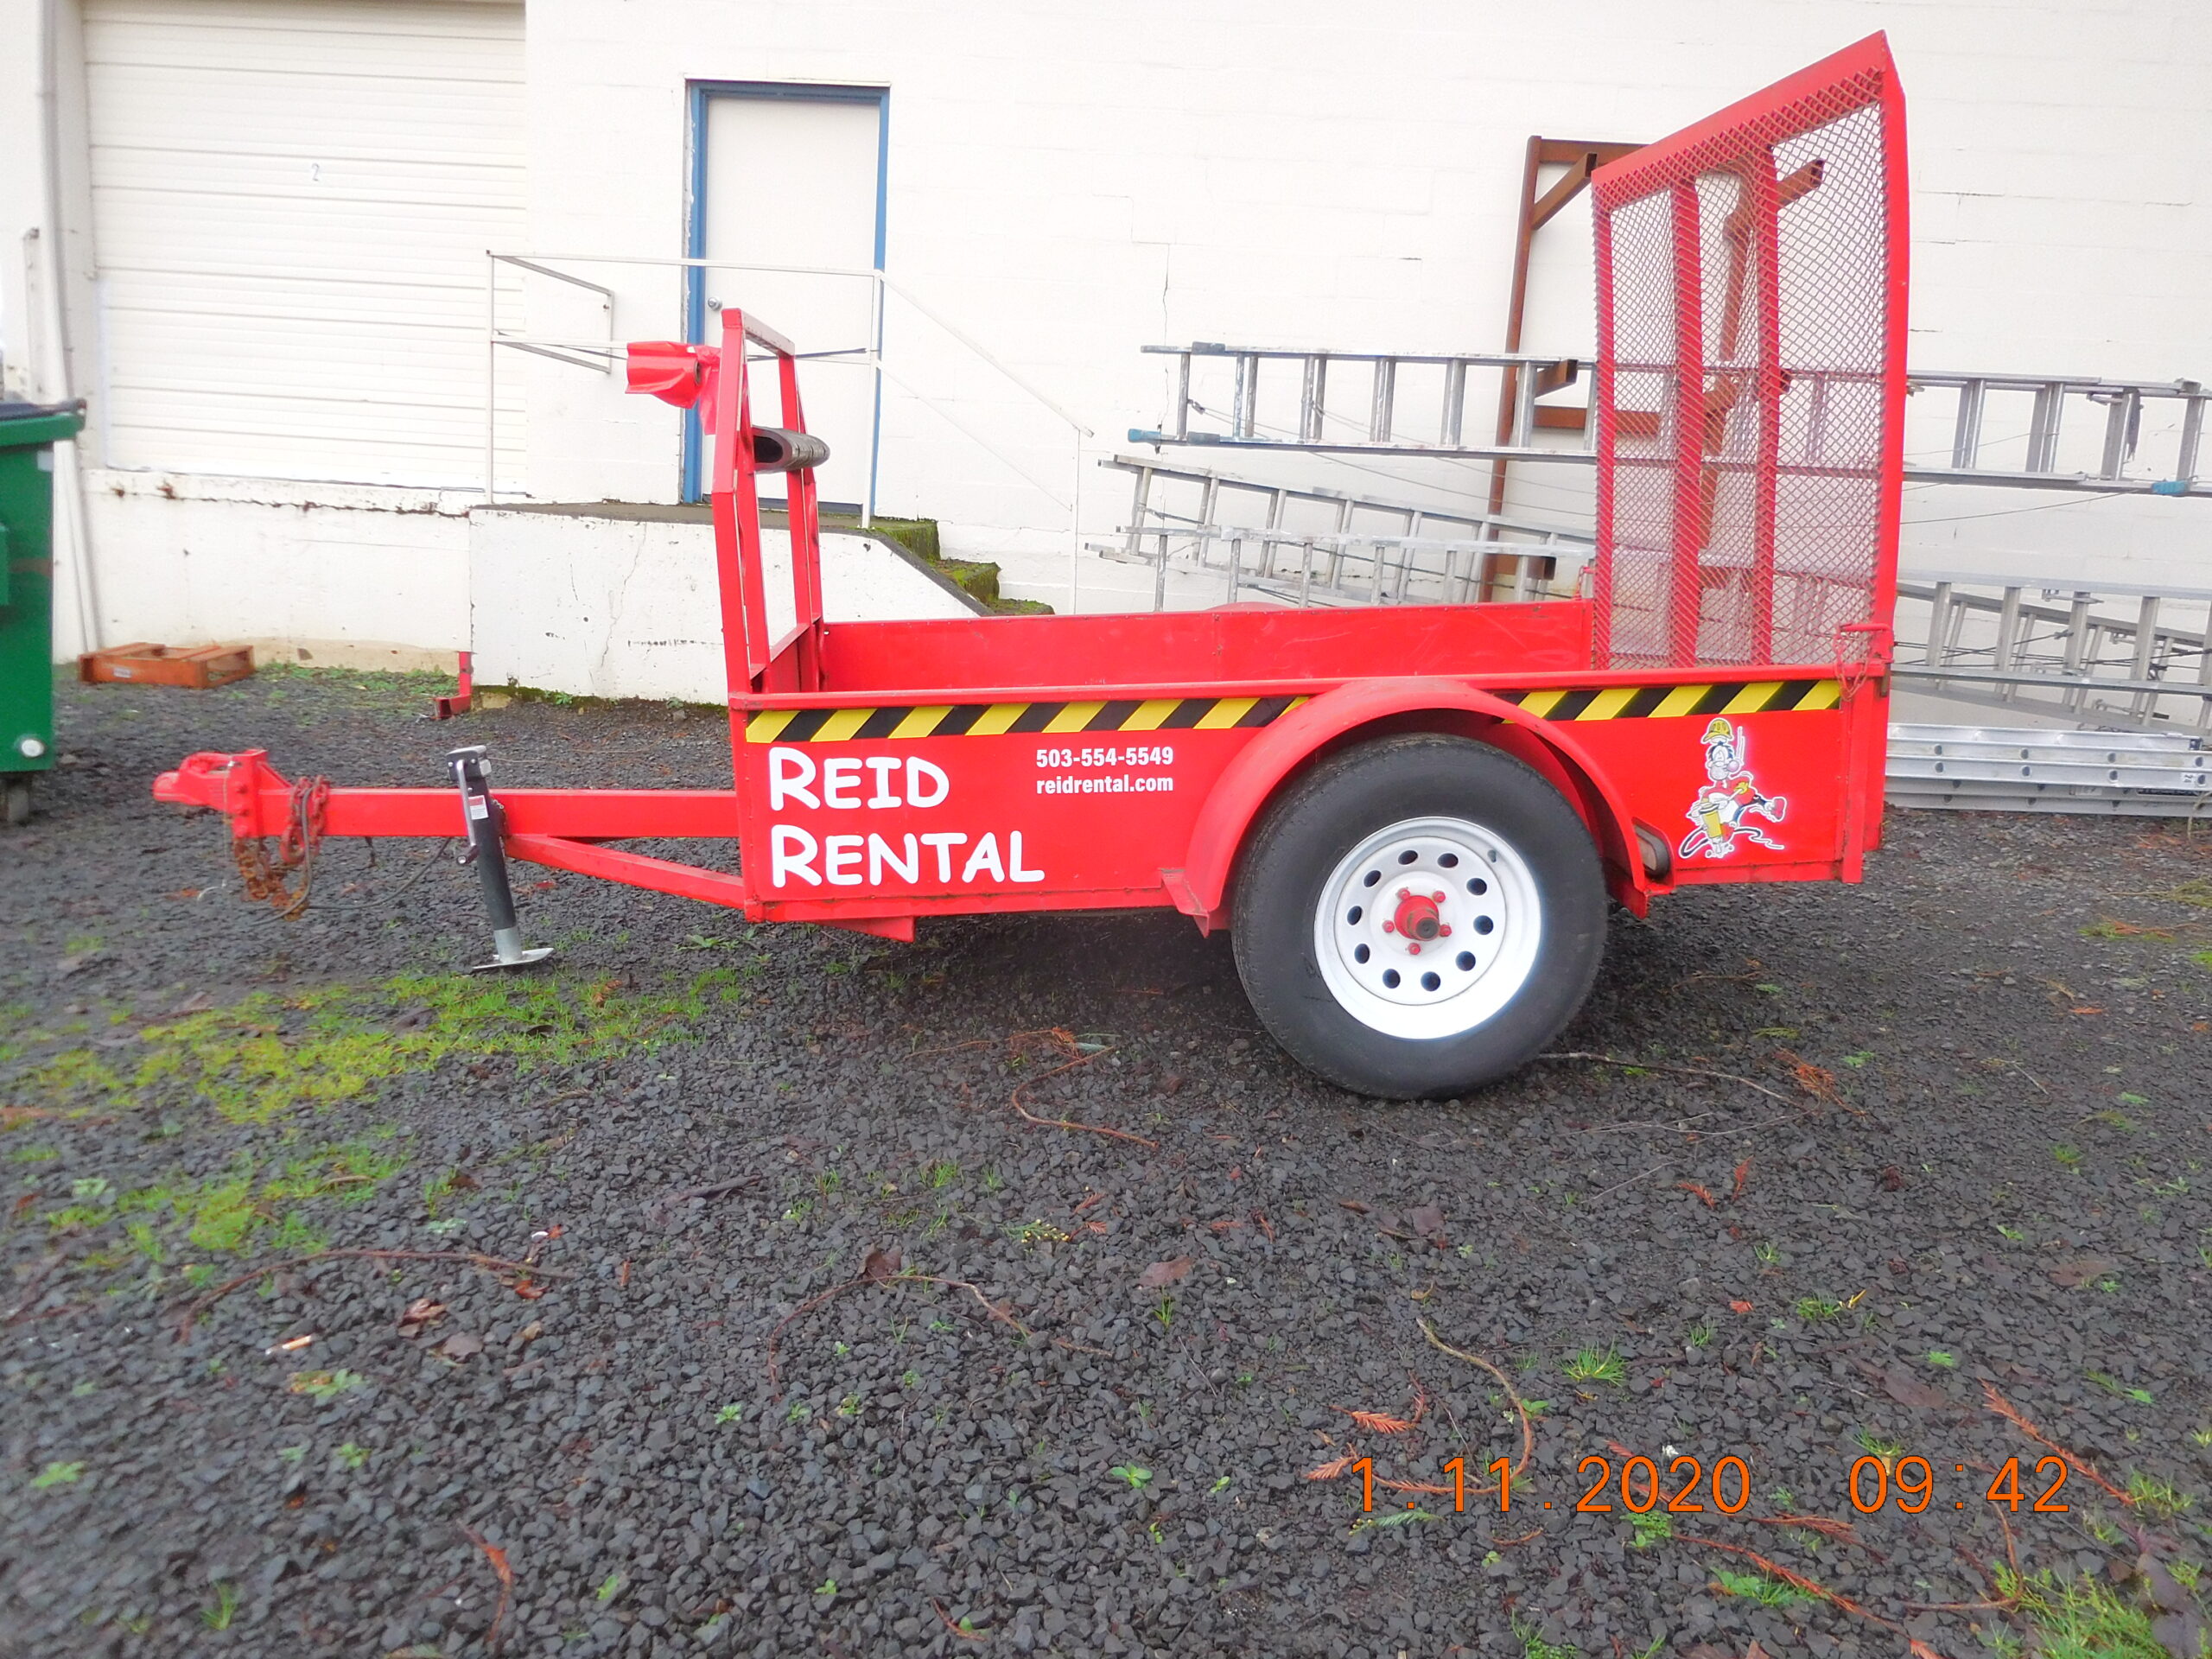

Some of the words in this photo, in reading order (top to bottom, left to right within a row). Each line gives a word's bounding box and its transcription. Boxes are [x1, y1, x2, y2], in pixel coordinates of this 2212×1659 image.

[311, 162, 320, 181] 2
[1036, 746, 1173, 767] 503-554-5549
[768, 747, 950, 811] REID
[1036, 773, 1173, 794] reidrental.com
[771, 823, 1046, 888] RENTAL
